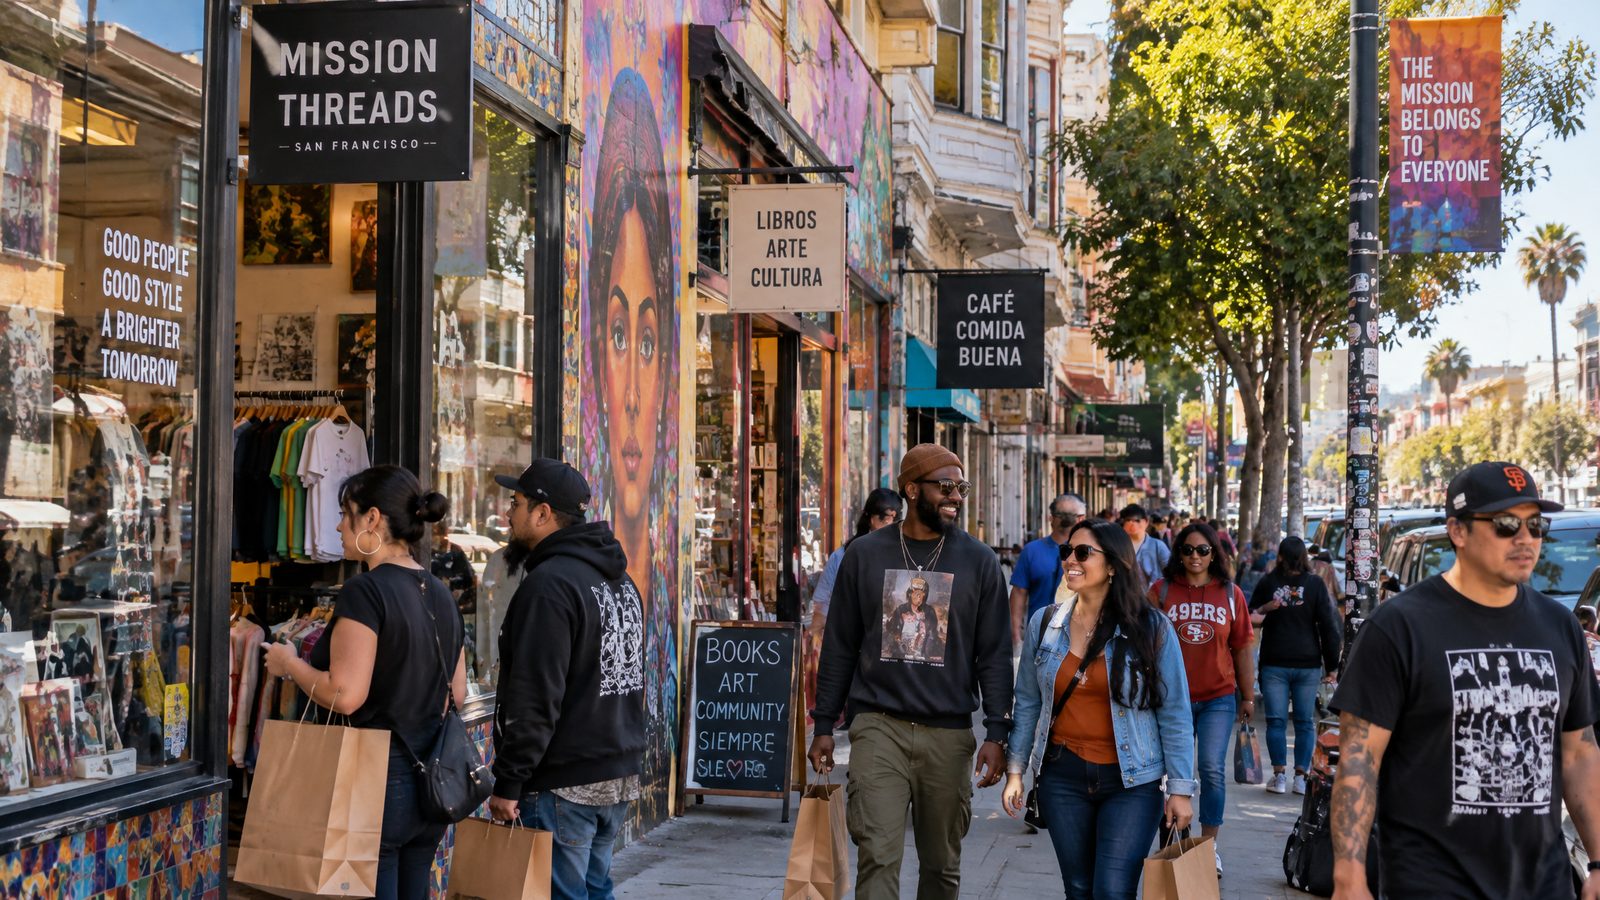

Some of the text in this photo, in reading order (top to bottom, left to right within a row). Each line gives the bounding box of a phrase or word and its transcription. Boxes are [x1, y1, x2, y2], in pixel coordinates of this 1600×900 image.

[279, 38, 437, 76] MISSION
[1401, 57, 1433, 79] THE
[1401, 82, 1473, 105] MISSION
[278, 90, 437, 127] THREADS
[1401, 108, 1481, 131] BELONGS
[295, 139, 419, 152] SAN FRANCISCO
[1401, 135, 1423, 157] TO
[1401, 159, 1490, 183] EVERYONE
[757, 210, 817, 230] LIBROS
[103, 227, 190, 278] GOOD PEOPLE
[766, 238, 808, 258] ARTE
[751, 267, 823, 288] CULTURA
[102, 267, 183, 313] GOOD STYLE
[967, 289, 1015, 314] CAFÉ
[101, 308, 180, 350] A BRIGHTER
[956, 320, 1025, 340] COMIDA
[959, 346, 1022, 366] BUENA
[101, 348, 178, 388] TOMORROW
[1167, 602, 1227, 626] 49ERS
[705, 637, 781, 665] BOOKS
[718, 672, 758, 693] ART
[696, 700, 785, 721] COMMUNITY
[698, 731, 775, 753] SIEMPRE
